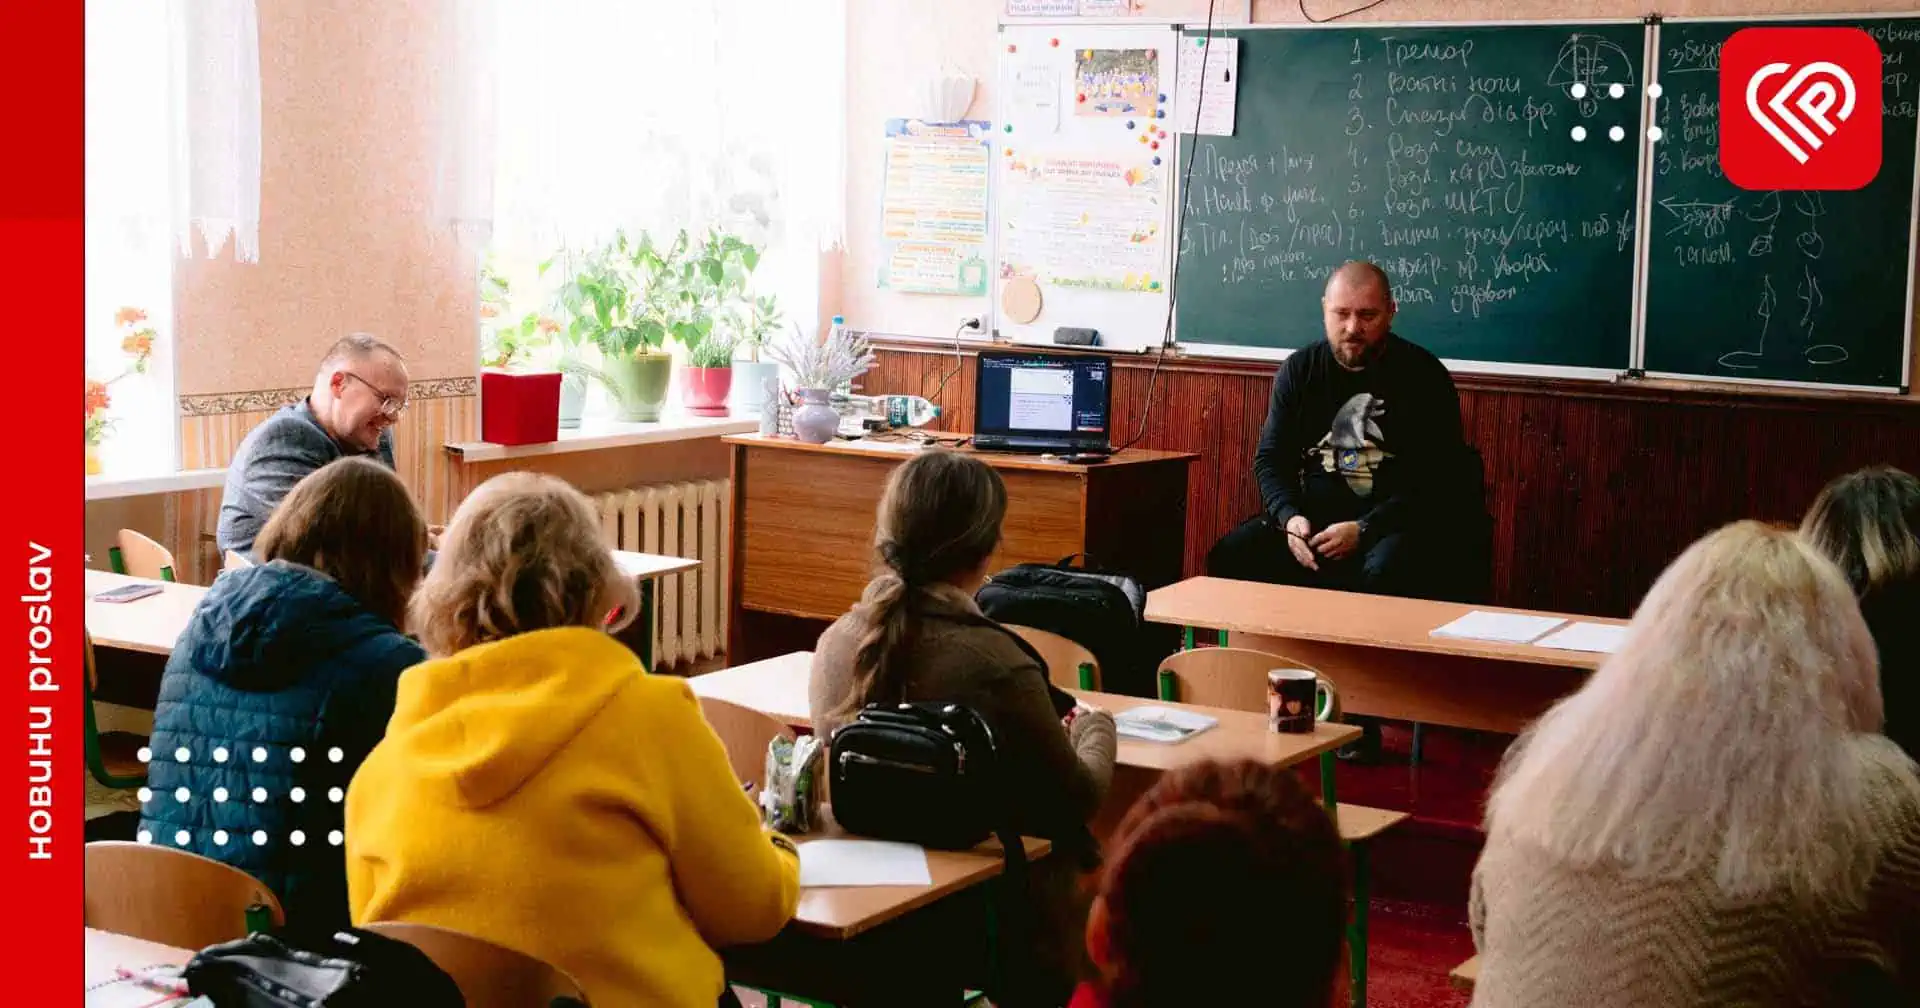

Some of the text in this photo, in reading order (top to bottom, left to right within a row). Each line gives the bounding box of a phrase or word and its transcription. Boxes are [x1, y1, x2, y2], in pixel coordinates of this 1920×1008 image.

[1349, 36, 1474, 69] 1. Тремор
[1345, 105, 1373, 136] 3.
